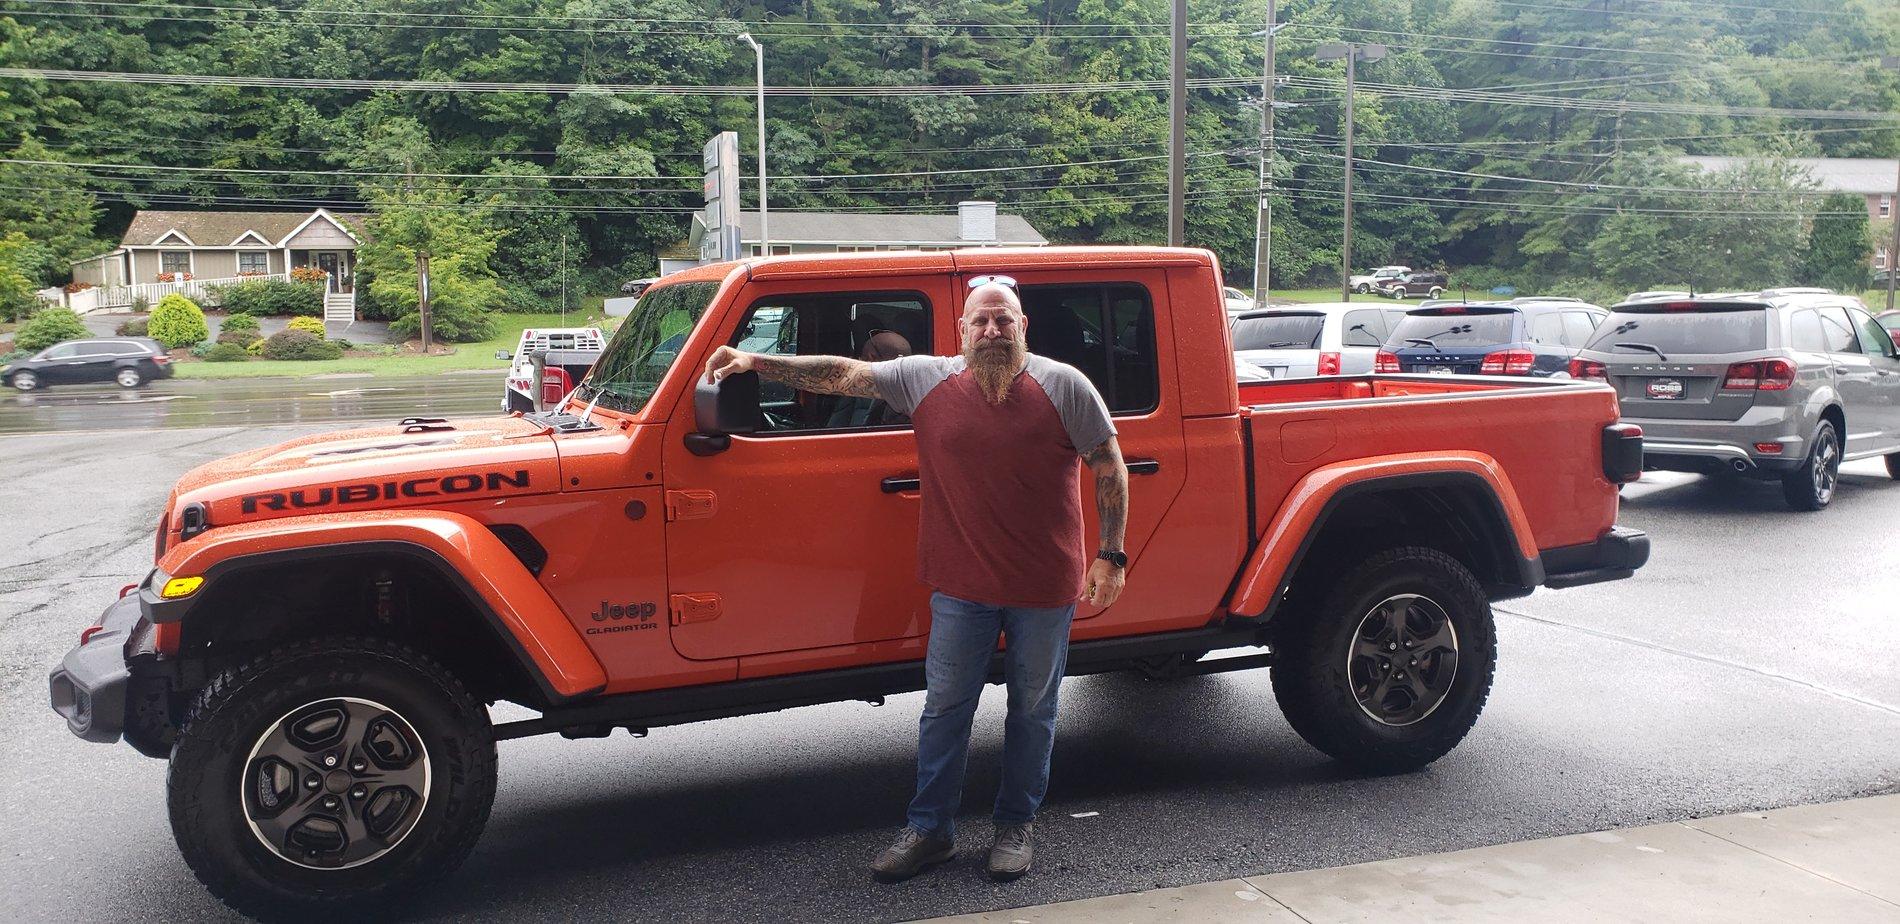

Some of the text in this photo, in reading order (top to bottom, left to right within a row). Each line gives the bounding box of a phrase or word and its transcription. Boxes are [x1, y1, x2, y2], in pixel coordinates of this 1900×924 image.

[242, 470, 530, 514] RUBICON
[591, 600, 656, 621] Jeep
[586, 622, 658, 635] GLADIATOR
